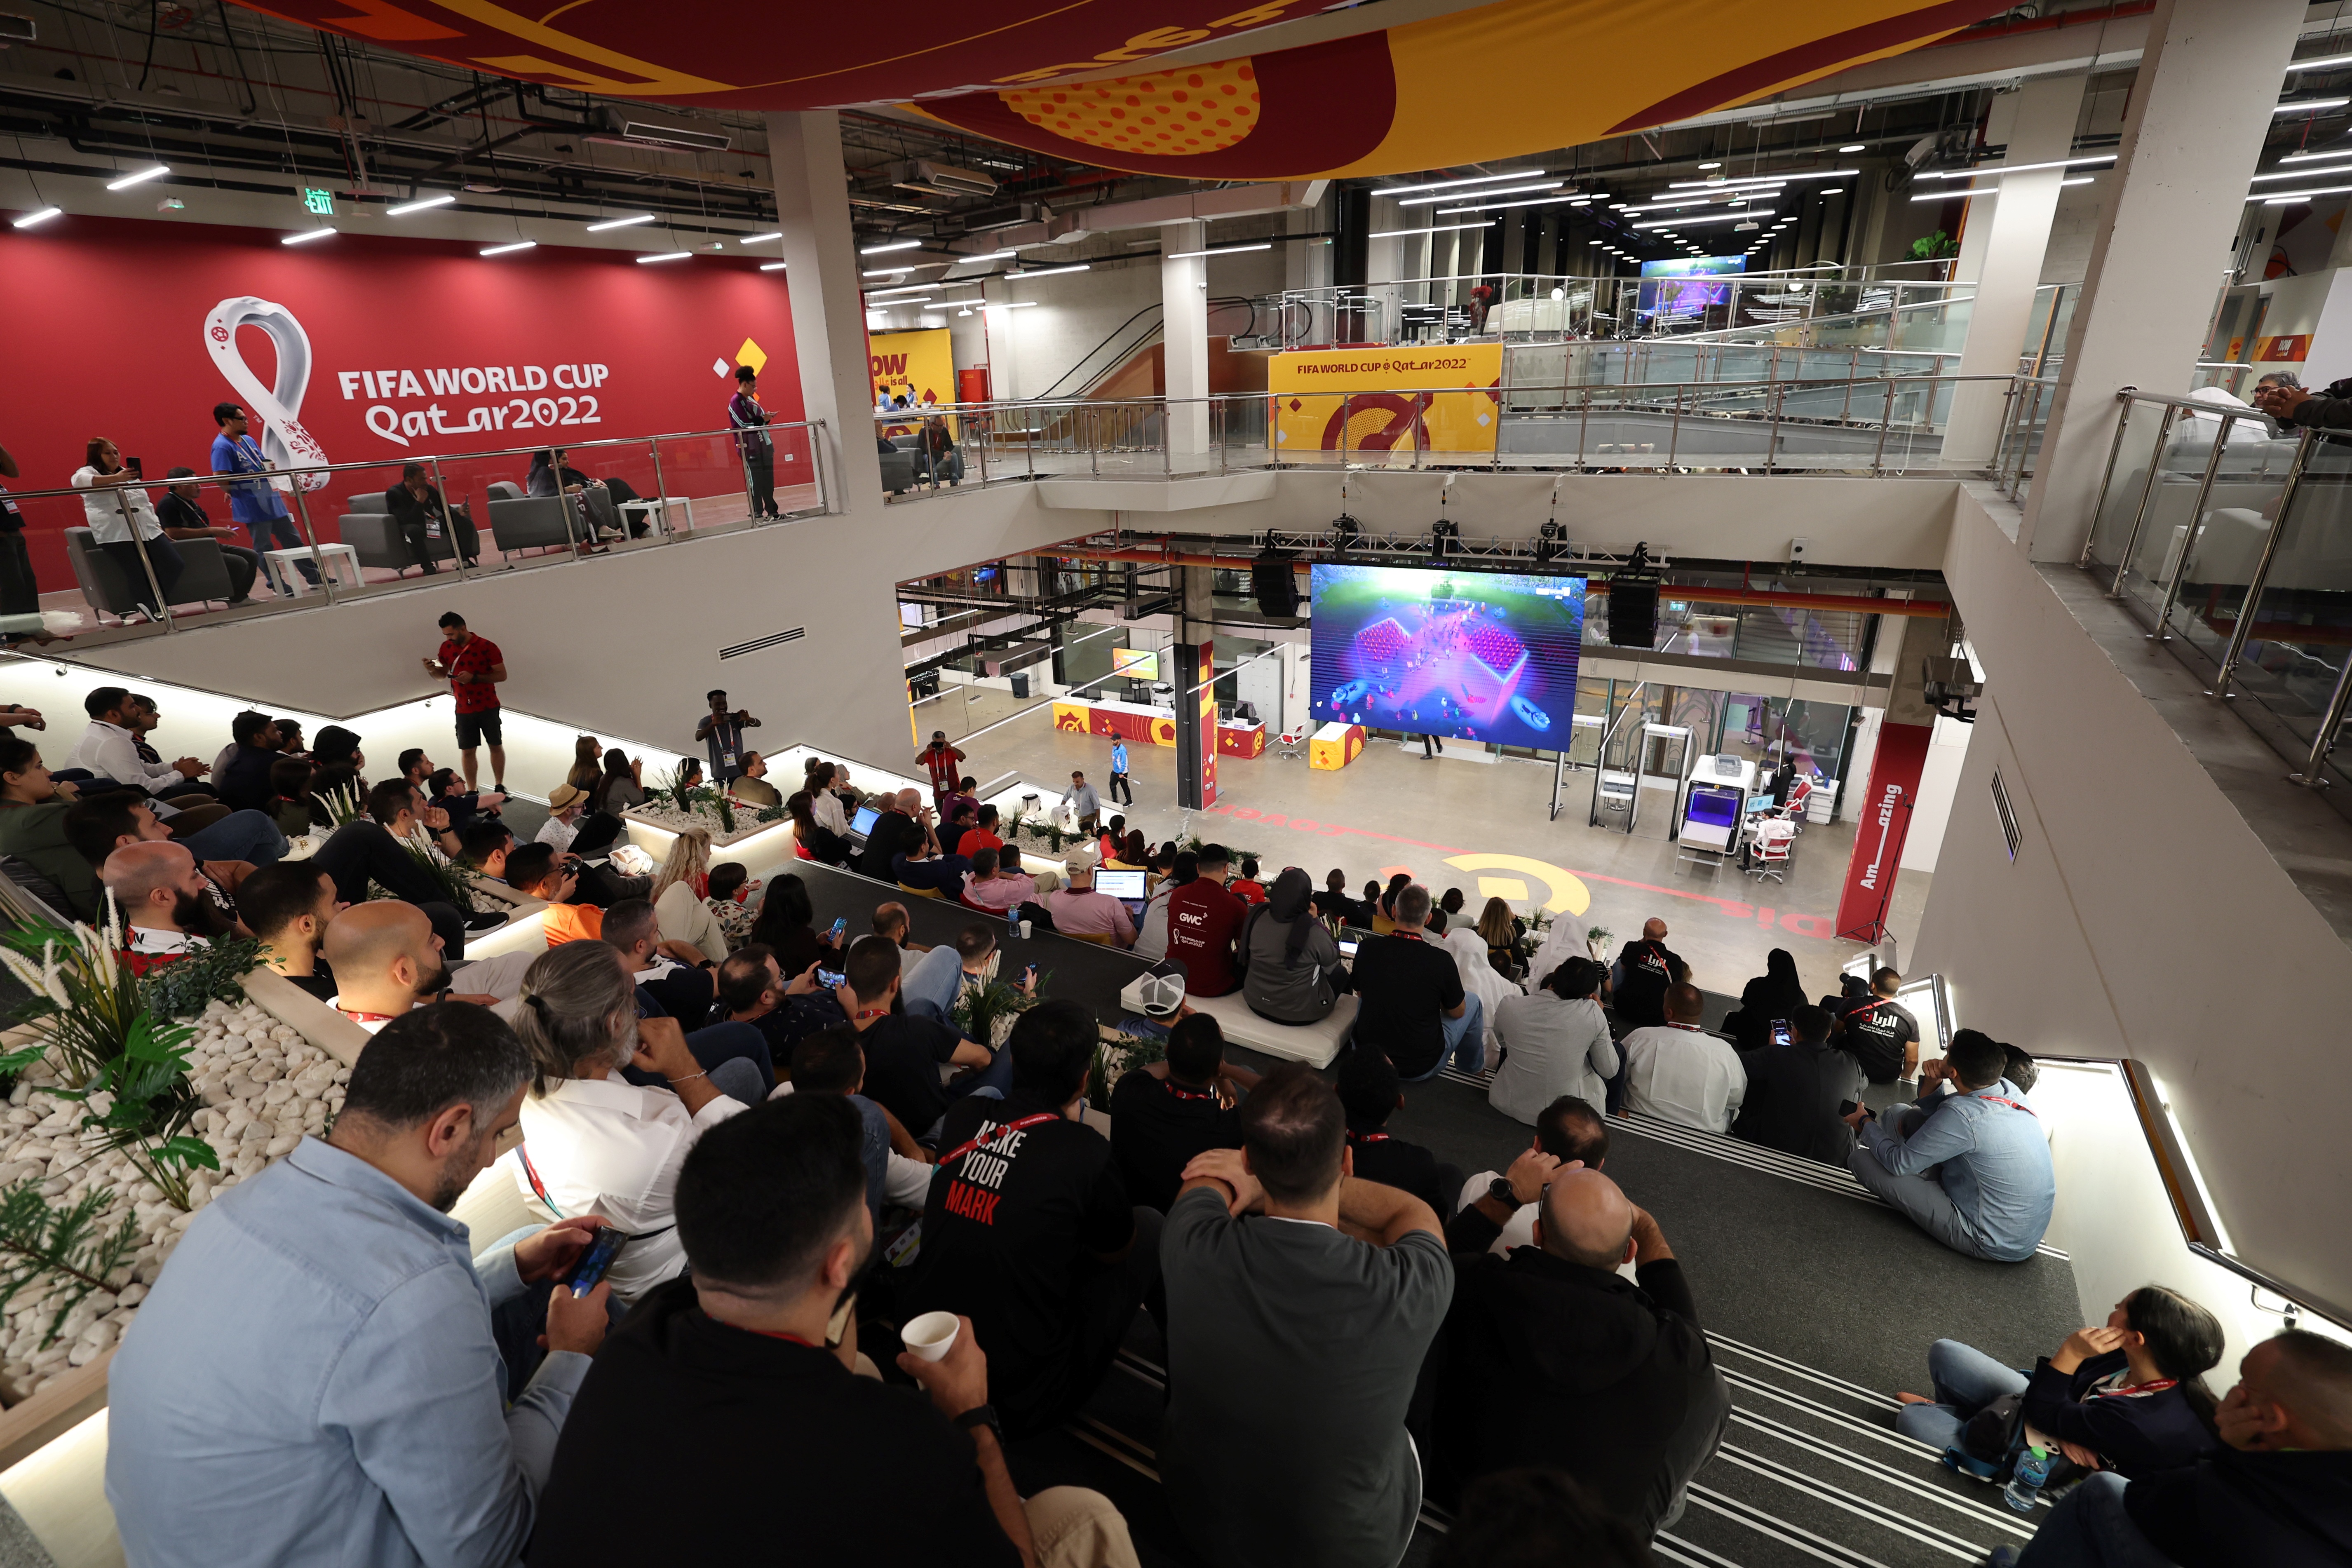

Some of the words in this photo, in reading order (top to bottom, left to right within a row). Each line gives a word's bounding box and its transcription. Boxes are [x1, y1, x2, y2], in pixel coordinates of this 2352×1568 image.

[306, 194, 333, 215] EXIT
[338, 370, 426, 400] FIFA
[423, 366, 548, 395] WORLD
[553, 364, 609, 389] CUP
[891, 376, 897, 386] is
[898, 375, 907, 385] all
[1298, 365, 1319, 374] FIFA
[1320, 364, 1358, 373] WORLD
[1360, 362, 1381, 372] CUP
[365, 395, 601, 446] Qatar2022
[1860, 784, 1902, 890] Amazing
[1179, 913, 1202, 925] GWC
[1861, 1011, 1898, 1028] الريان
[959, 1151, 1009, 1190] YOUR
[945, 1180, 1001, 1225] MARK
